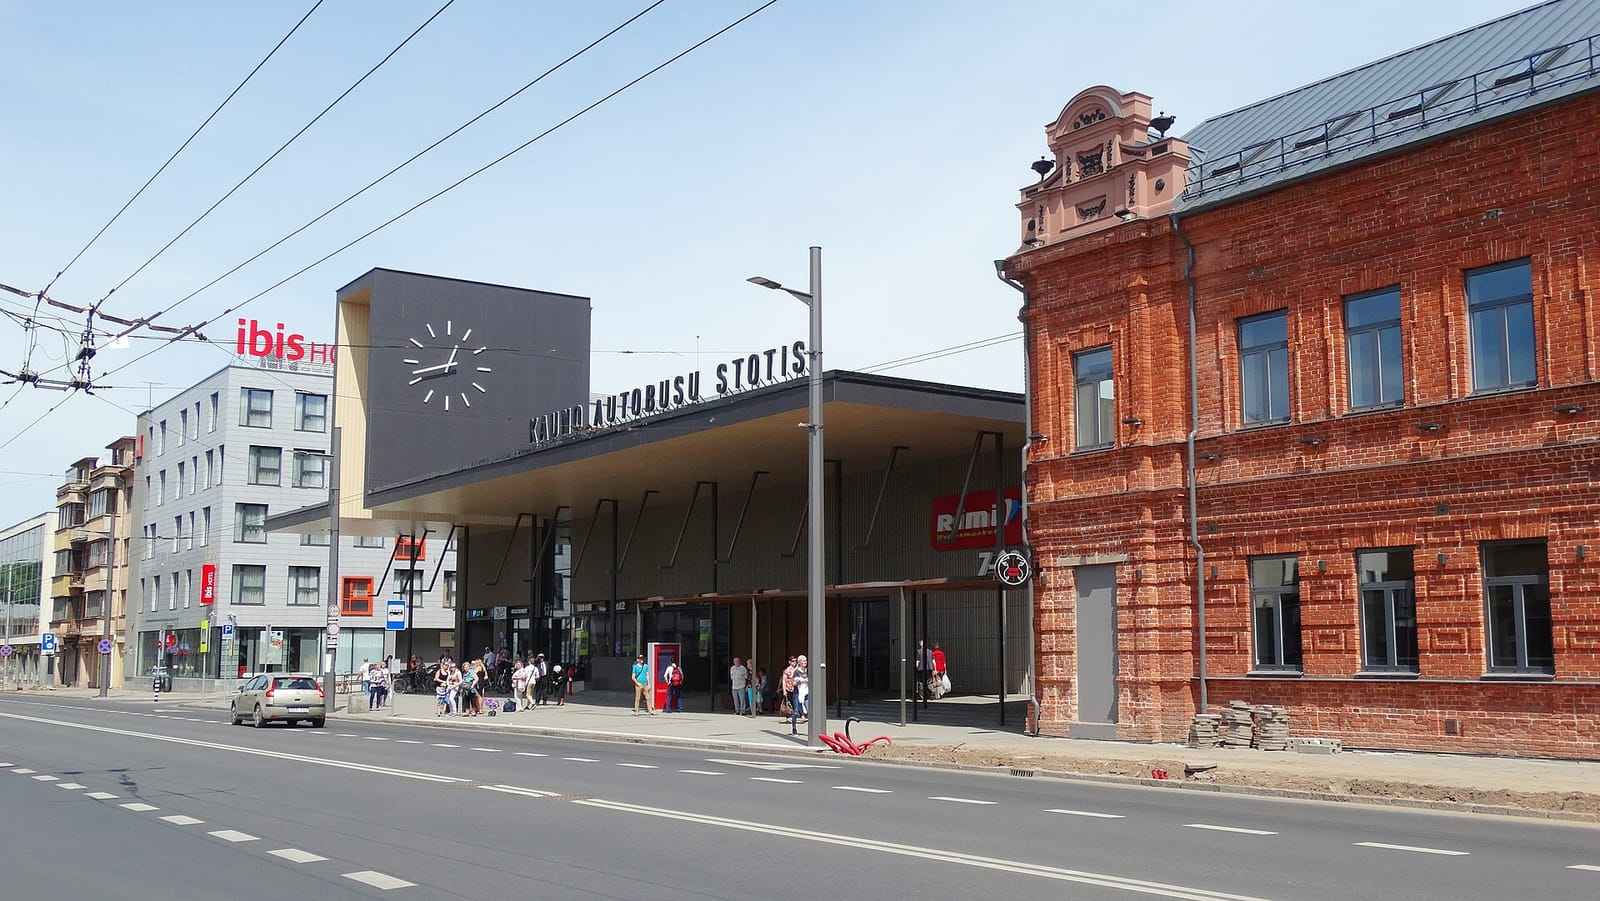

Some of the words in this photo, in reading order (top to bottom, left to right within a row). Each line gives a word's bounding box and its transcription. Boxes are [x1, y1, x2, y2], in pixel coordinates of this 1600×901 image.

[237, 319, 304, 360] ibis
[529, 404, 583, 444] KAUNO
[716, 340, 806, 394] STOTIS
[937, 505, 997, 532] Rimi
[204, 586, 213, 599] ibis
[45, 634, 52, 643] P
[225, 626, 231, 634] P
